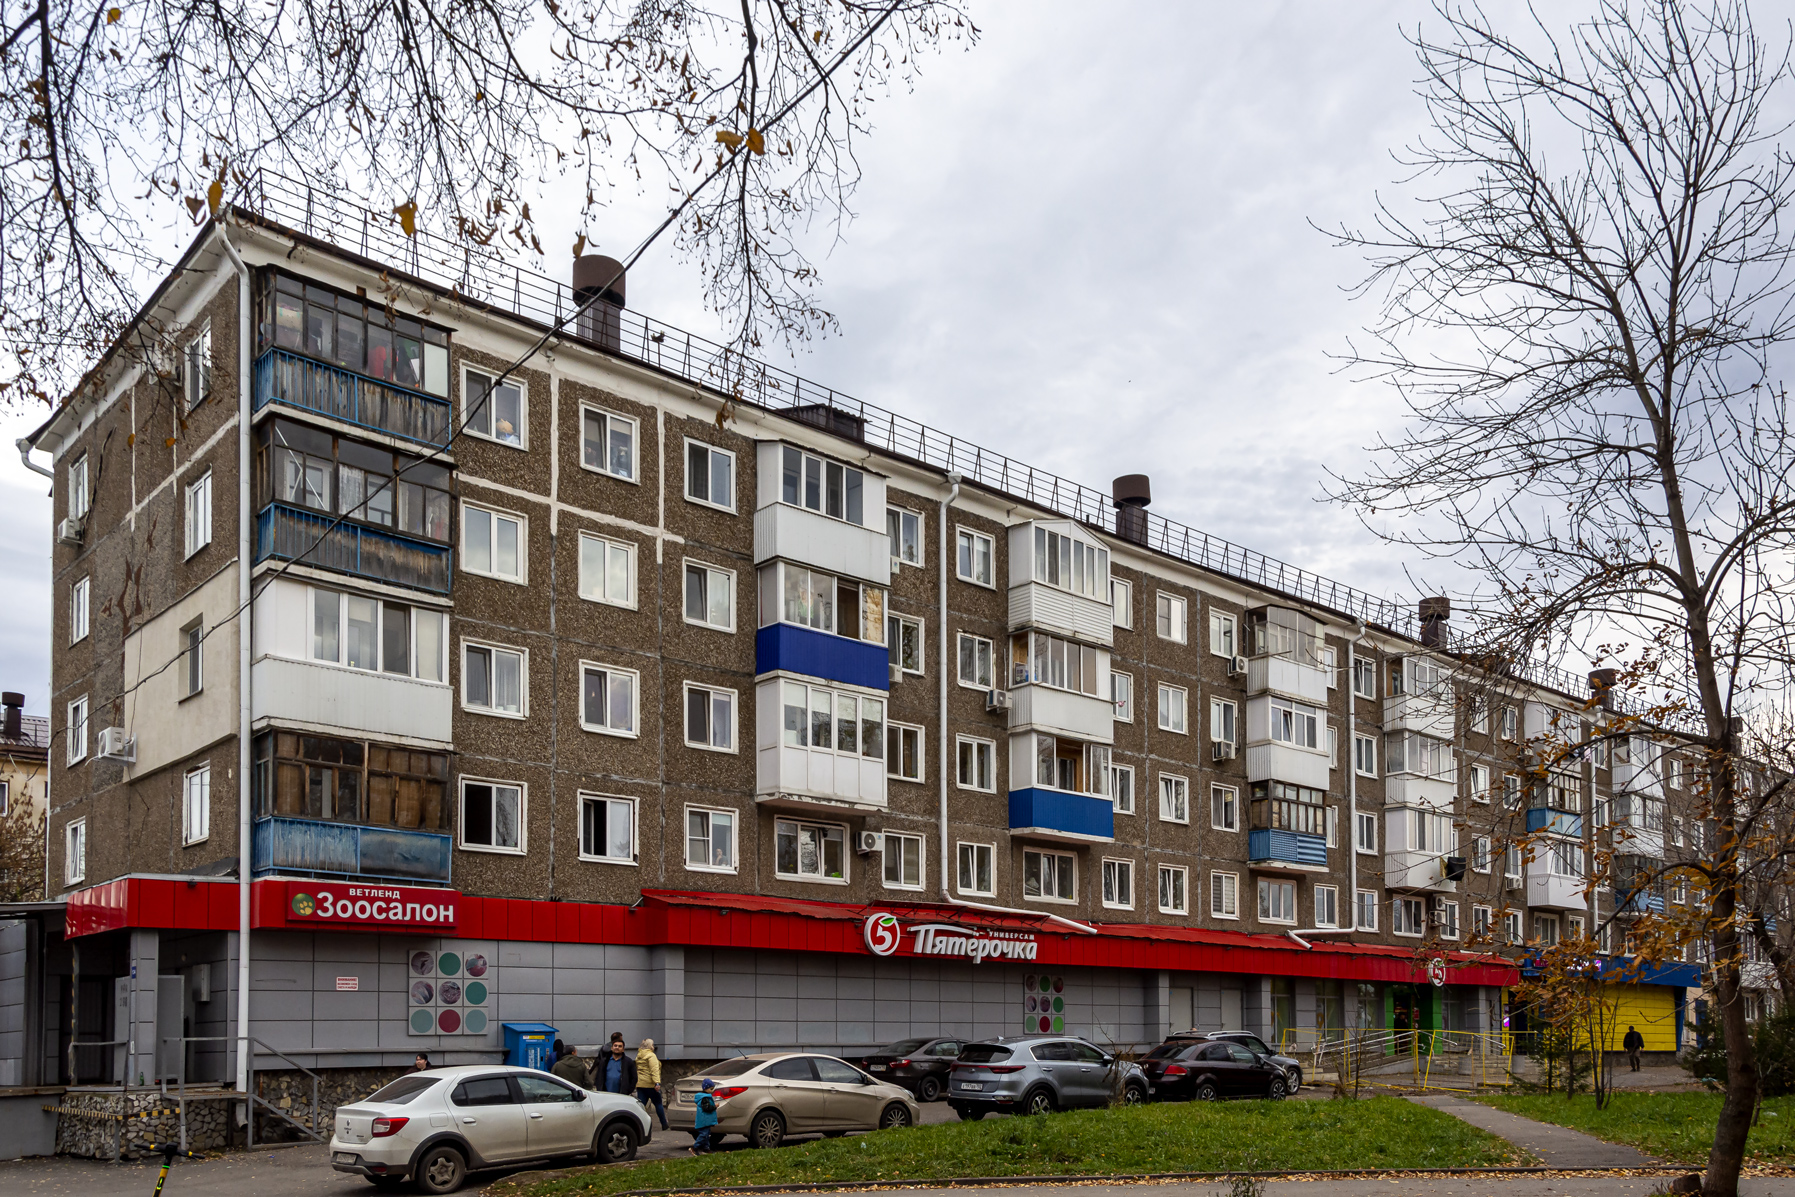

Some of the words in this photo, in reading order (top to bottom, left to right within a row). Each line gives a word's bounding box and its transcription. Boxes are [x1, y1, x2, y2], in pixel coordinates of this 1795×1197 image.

[349, 888, 401, 900] ВЕТЛЕНД
[316, 891, 454, 923] Зоосалон
[989, 930, 1035, 941] УНИВЕРСАМ
